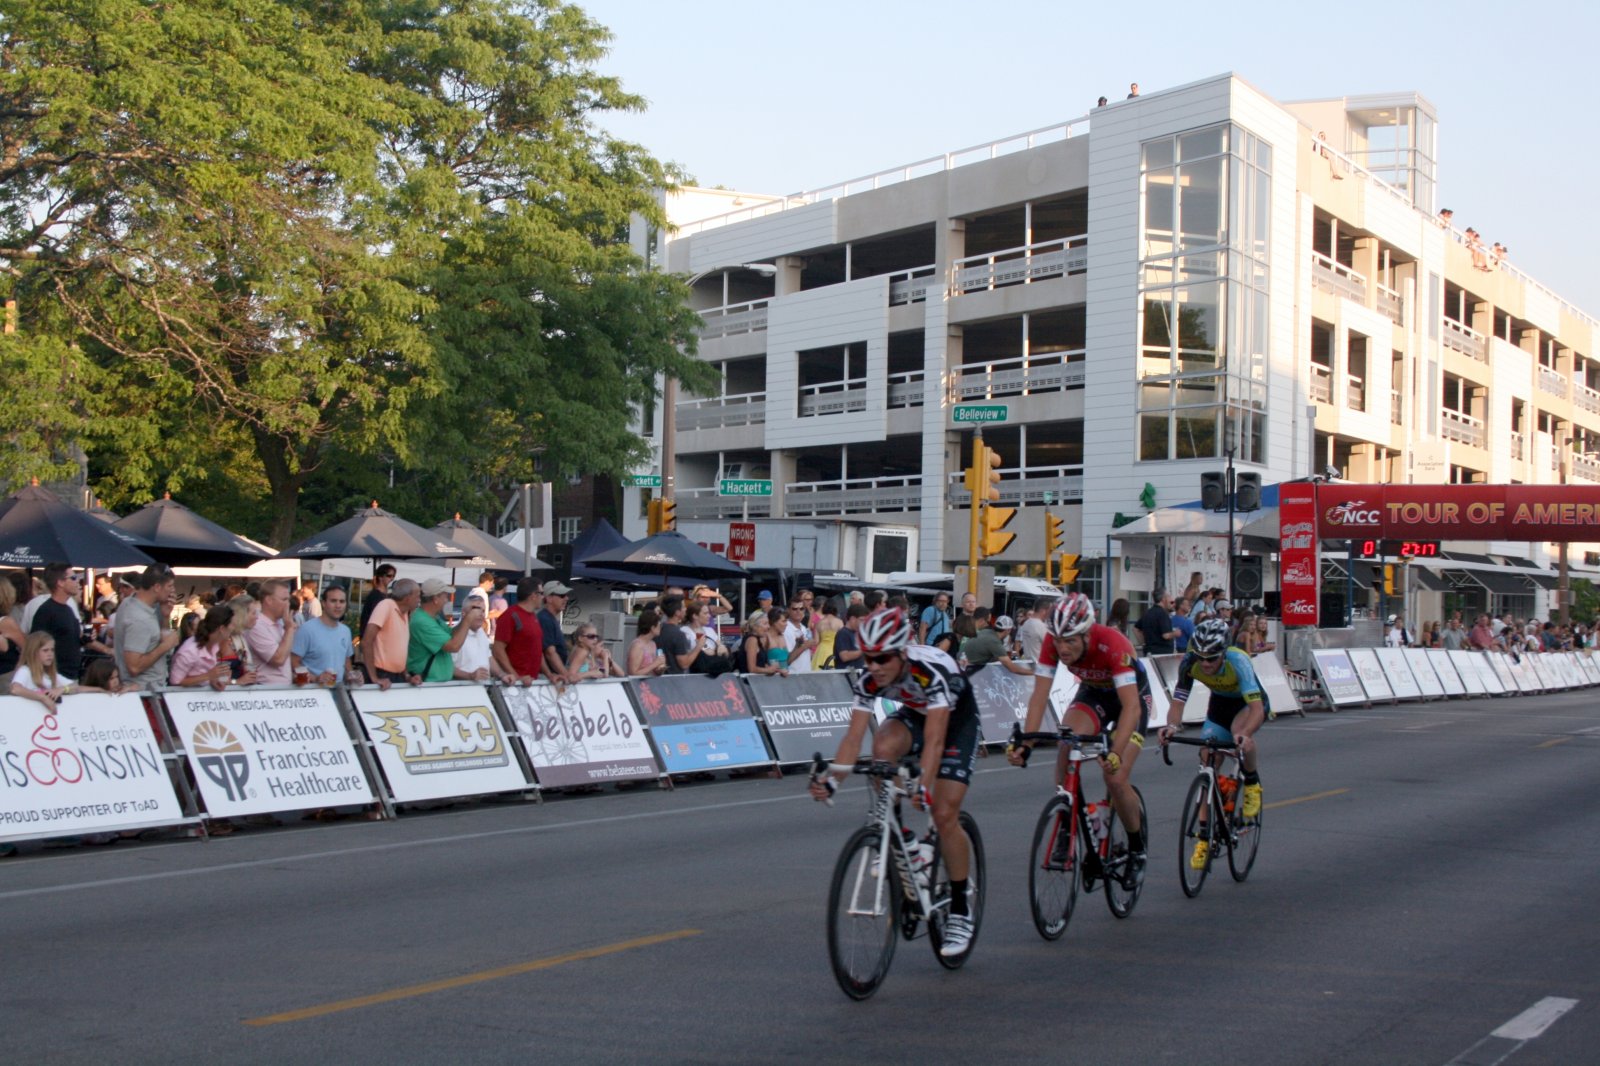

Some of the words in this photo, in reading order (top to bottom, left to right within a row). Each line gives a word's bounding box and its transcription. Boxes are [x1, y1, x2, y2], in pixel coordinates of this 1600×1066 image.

[959, 408, 998, 420] Belleview
[727, 481, 762, 494] Hackett
[1343, 510, 1380, 523] NCC
[1386, 502, 1460, 525] TOUR
[1466, 502, 1505, 525] OF
[730, 527, 755, 540] WRONG
[734, 544, 750, 557] WAY
[1363, 540, 1375, 555] 0
[1401, 542, 1436, 556] 27:17
[1294, 604, 1315, 613] NCC
[187, 700, 231, 713] OFFICIAL
[231, 698, 272, 711] MEDICAL
[273, 697, 319, 710] PROVIDER
[665, 700, 730, 720] HOLLANDER
[526, 699, 633, 742] belabela
[764, 708, 819, 726] DOWNER
[70, 726, 147, 744] Federation
[244, 720, 327, 745] Wheaton
[386, 711, 497, 757] RACC
[256, 746, 350, 771] Franciscan
[266, 771, 363, 798] Healthcare
[0, 810, 40, 825] PROUD
[41, 804, 112, 822] SUPPORTER
[113, 801, 129, 815] OF
[130, 798, 159, 812] ToAD
